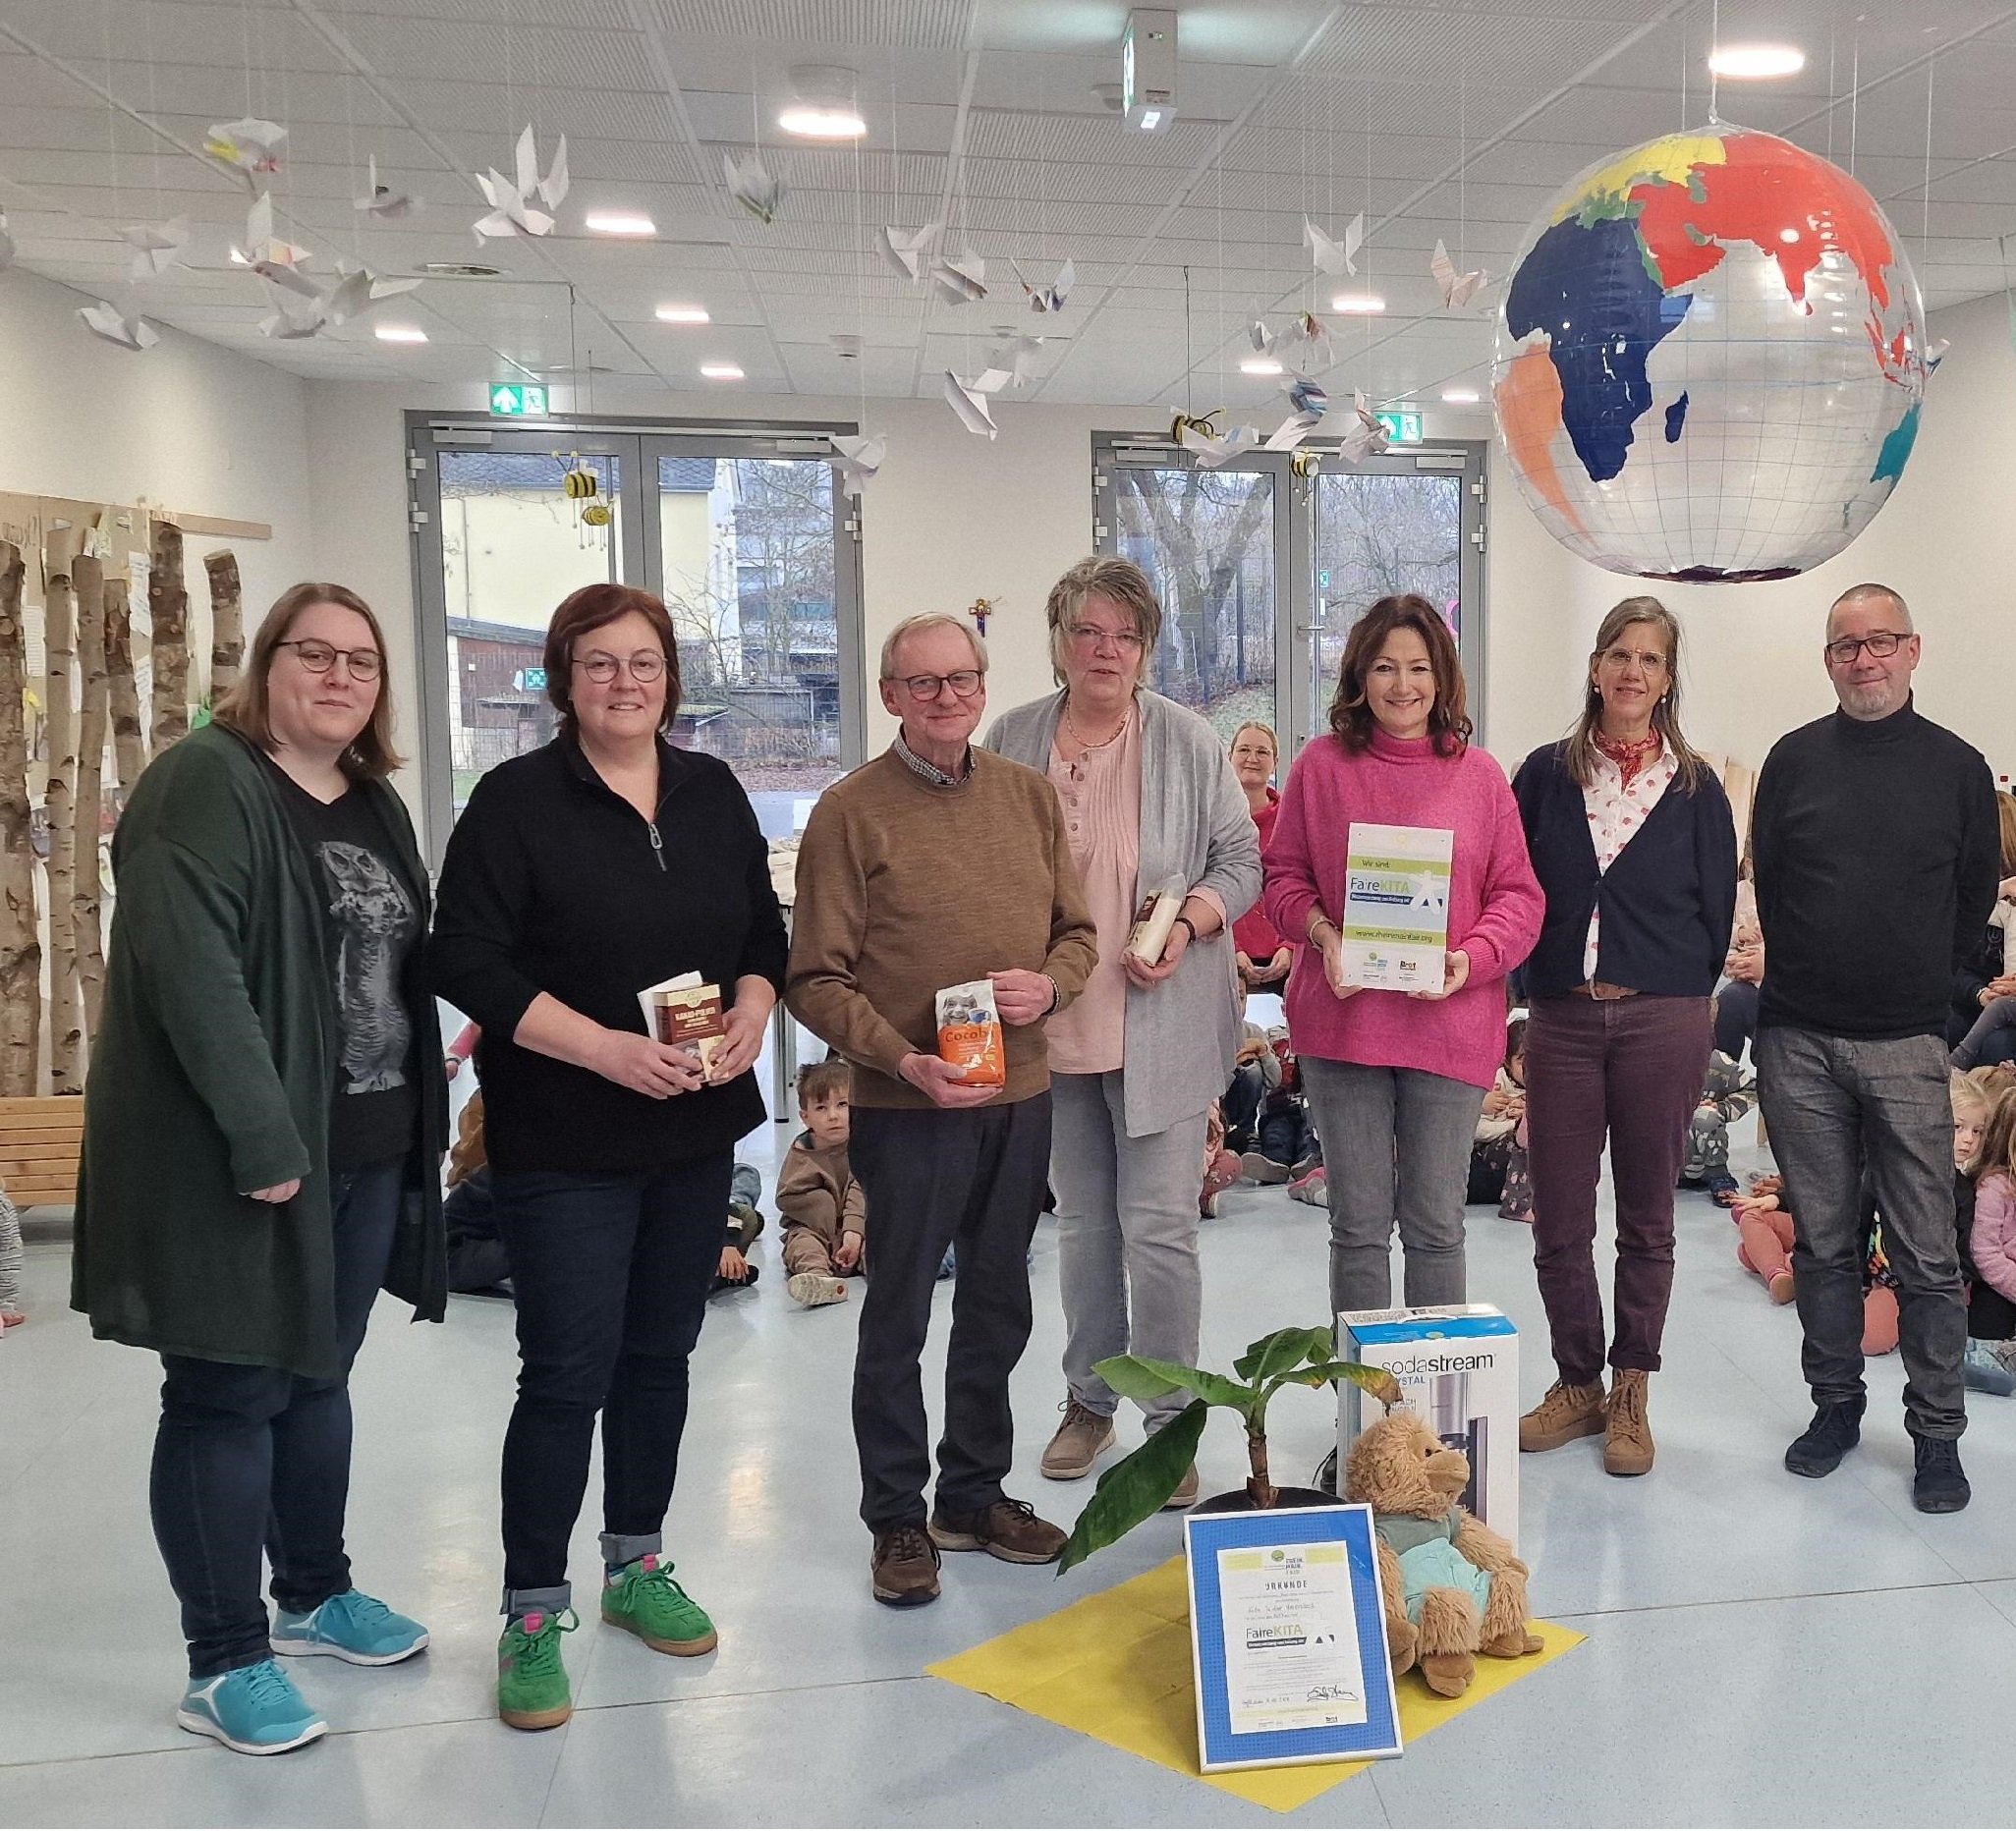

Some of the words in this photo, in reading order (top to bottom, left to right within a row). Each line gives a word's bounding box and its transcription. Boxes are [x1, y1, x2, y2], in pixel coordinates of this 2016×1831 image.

[1350, 877, 1410, 894] FaireKITA
[1381, 1354, 1493, 1374] sodastream
[1246, 1624, 1304, 1639] FaireKITA
